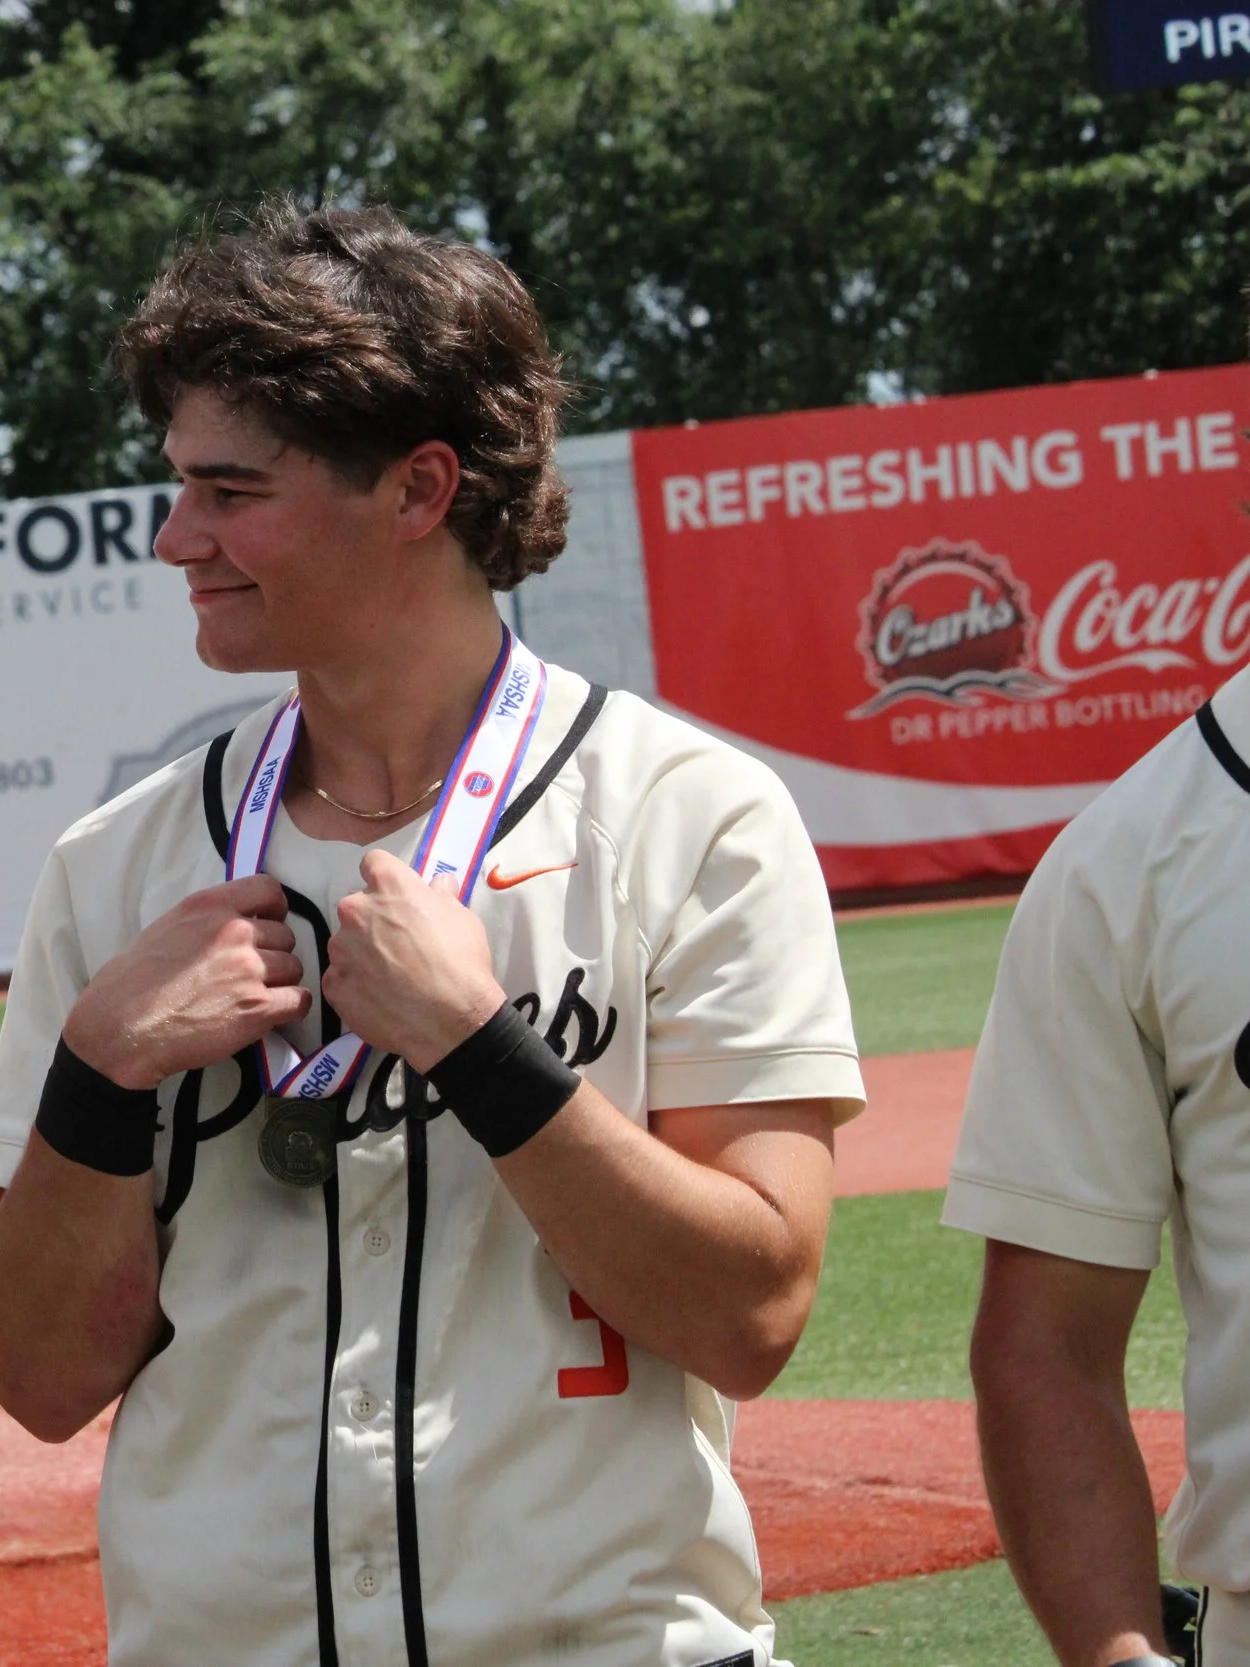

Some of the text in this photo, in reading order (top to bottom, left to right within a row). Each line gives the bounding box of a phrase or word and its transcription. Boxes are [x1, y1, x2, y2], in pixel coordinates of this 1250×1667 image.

[1163, 13, 1250, 64] PIR
[661, 412, 1238, 533] REFRESHING THE
[876, 588, 1015, 666] Ozarks
[891, 684, 1206, 745] DR PEPPER BOTTLING
[249, 756, 281, 814] MSHSAA
[298, 1053, 340, 1100] MSHS
